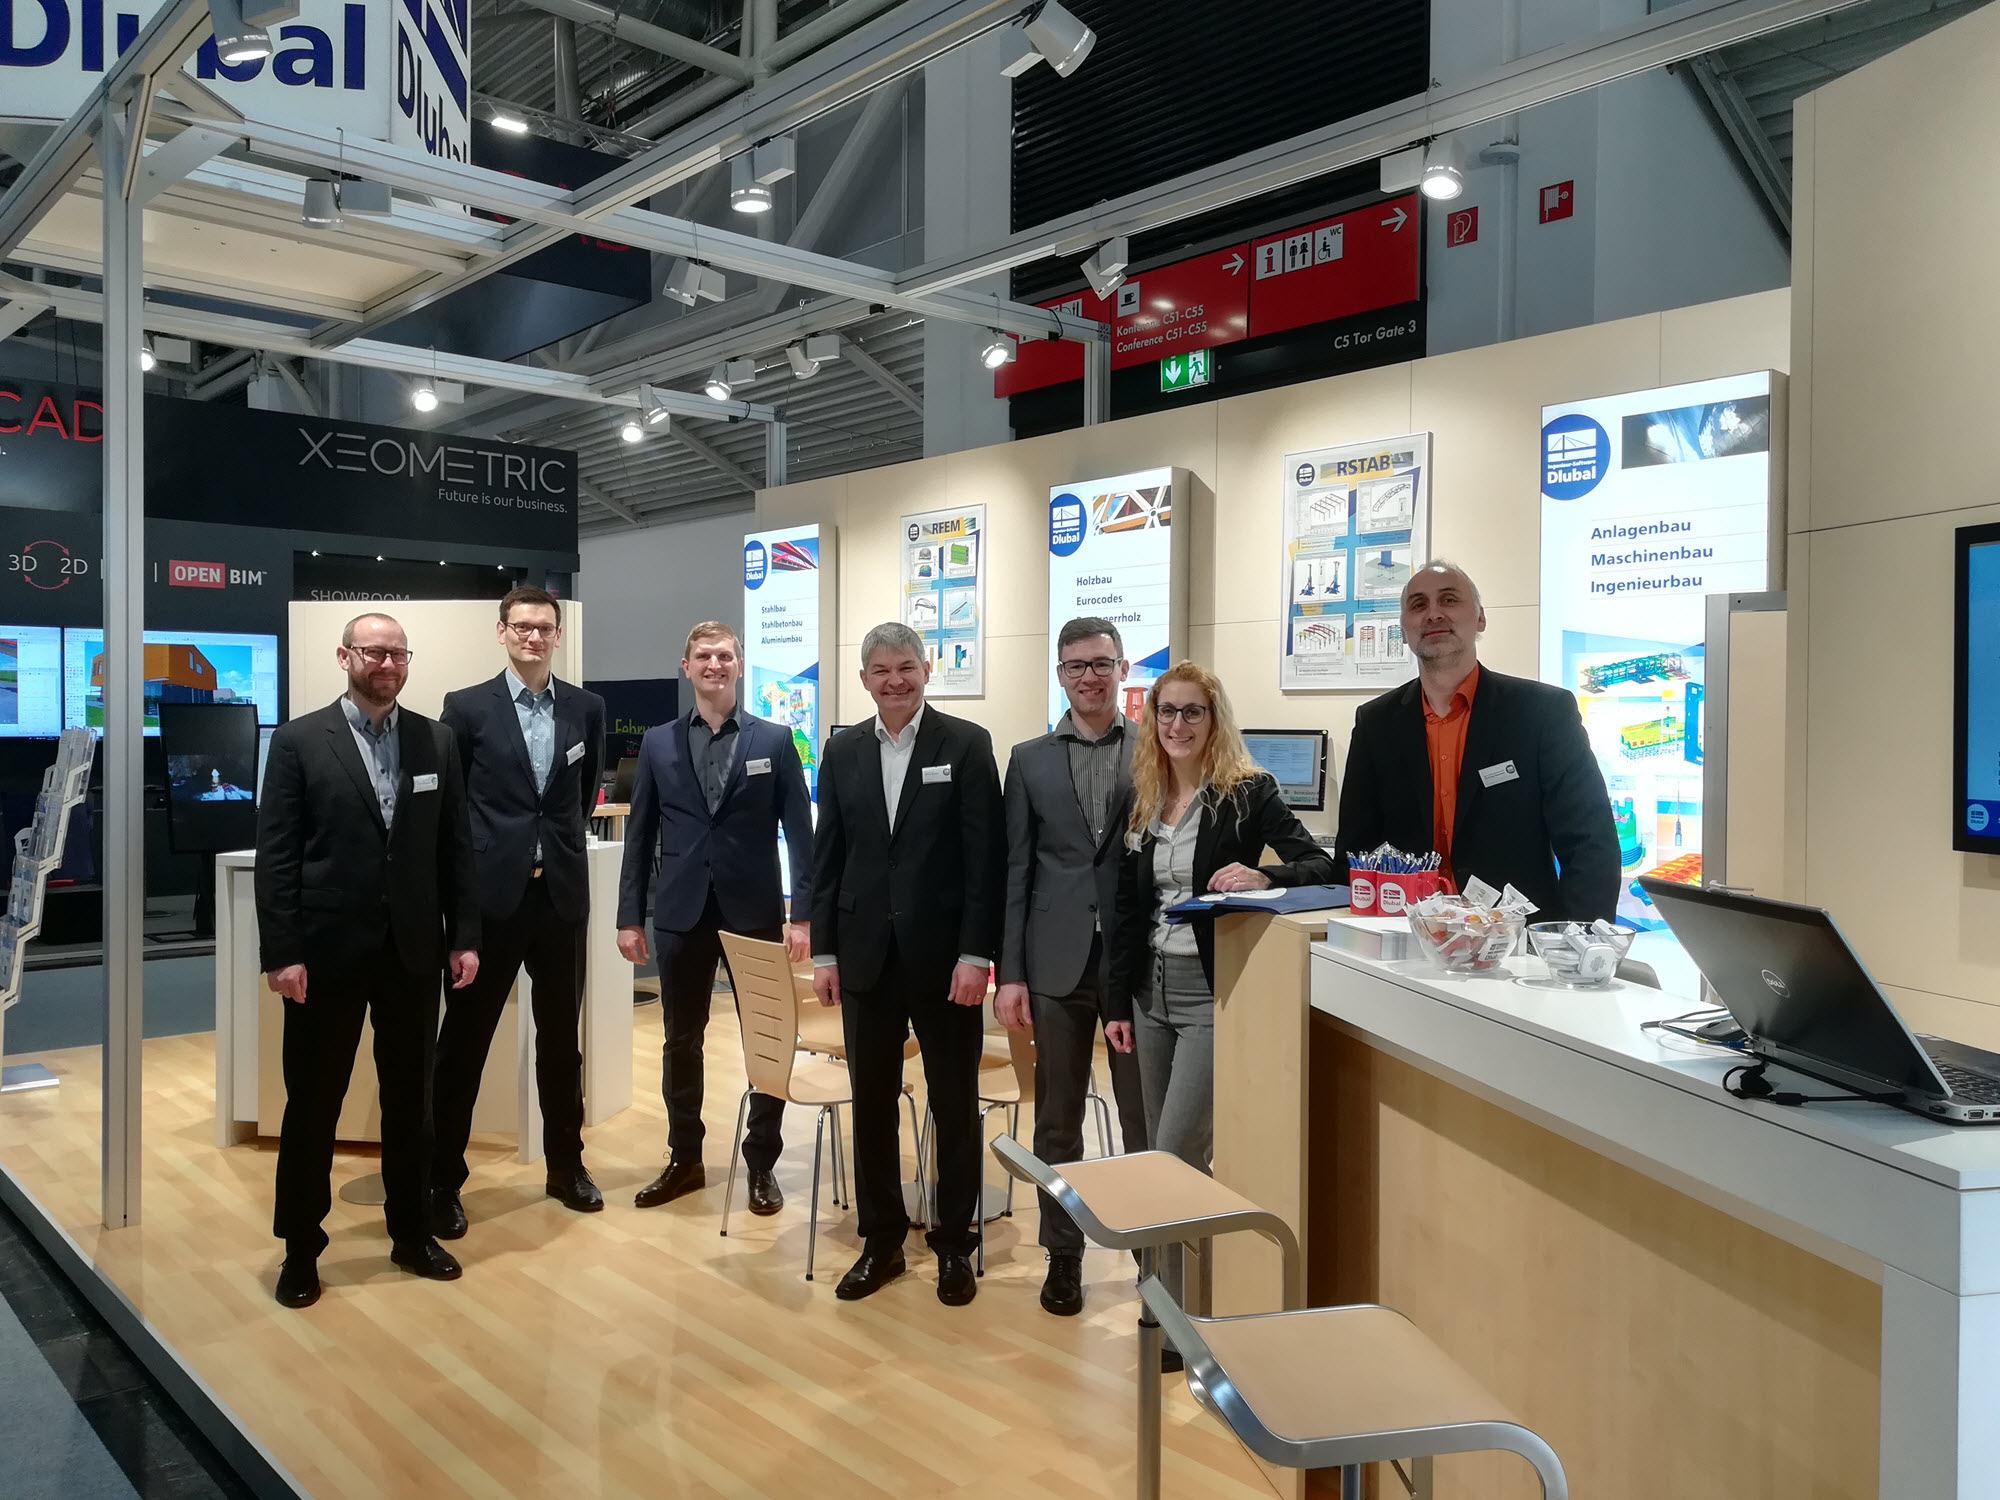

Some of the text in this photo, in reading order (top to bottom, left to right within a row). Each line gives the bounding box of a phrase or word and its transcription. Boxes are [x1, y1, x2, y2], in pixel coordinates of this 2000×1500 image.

[1330, 226, 1342, 237] WC
[1163, 304, 1205, 325] C51-C55
[1117, 320, 1208, 354] Conference C51-C55
[1334, 319, 1417, 349] C5 Tor Gate 3
[298, 428, 567, 494] XEOMETRIC
[1336, 454, 1391, 477] RSTAB
[1547, 465, 1597, 484] Dlubal
[438, 488, 568, 514] Future is our business.
[932, 519, 961, 535] RFEM
[1591, 520, 1692, 540] Anlagenbau
[1052, 531, 1080, 545] Dlubal
[8, 554, 88, 575] 3D 2D
[1591, 546, 1714, 567] Maschinenbau
[174, 565, 221, 583] OPEN
[1076, 574, 1113, 587] Holzbau
[1591, 574, 1703, 595] Ingenieurbau
[1076, 593, 1123, 606] Eurocodes
[761, 605, 786, 614] Stahlbau
[761, 619, 803, 630] Stahlbetonbau
[761, 635, 803, 645] Aluminiumbau
